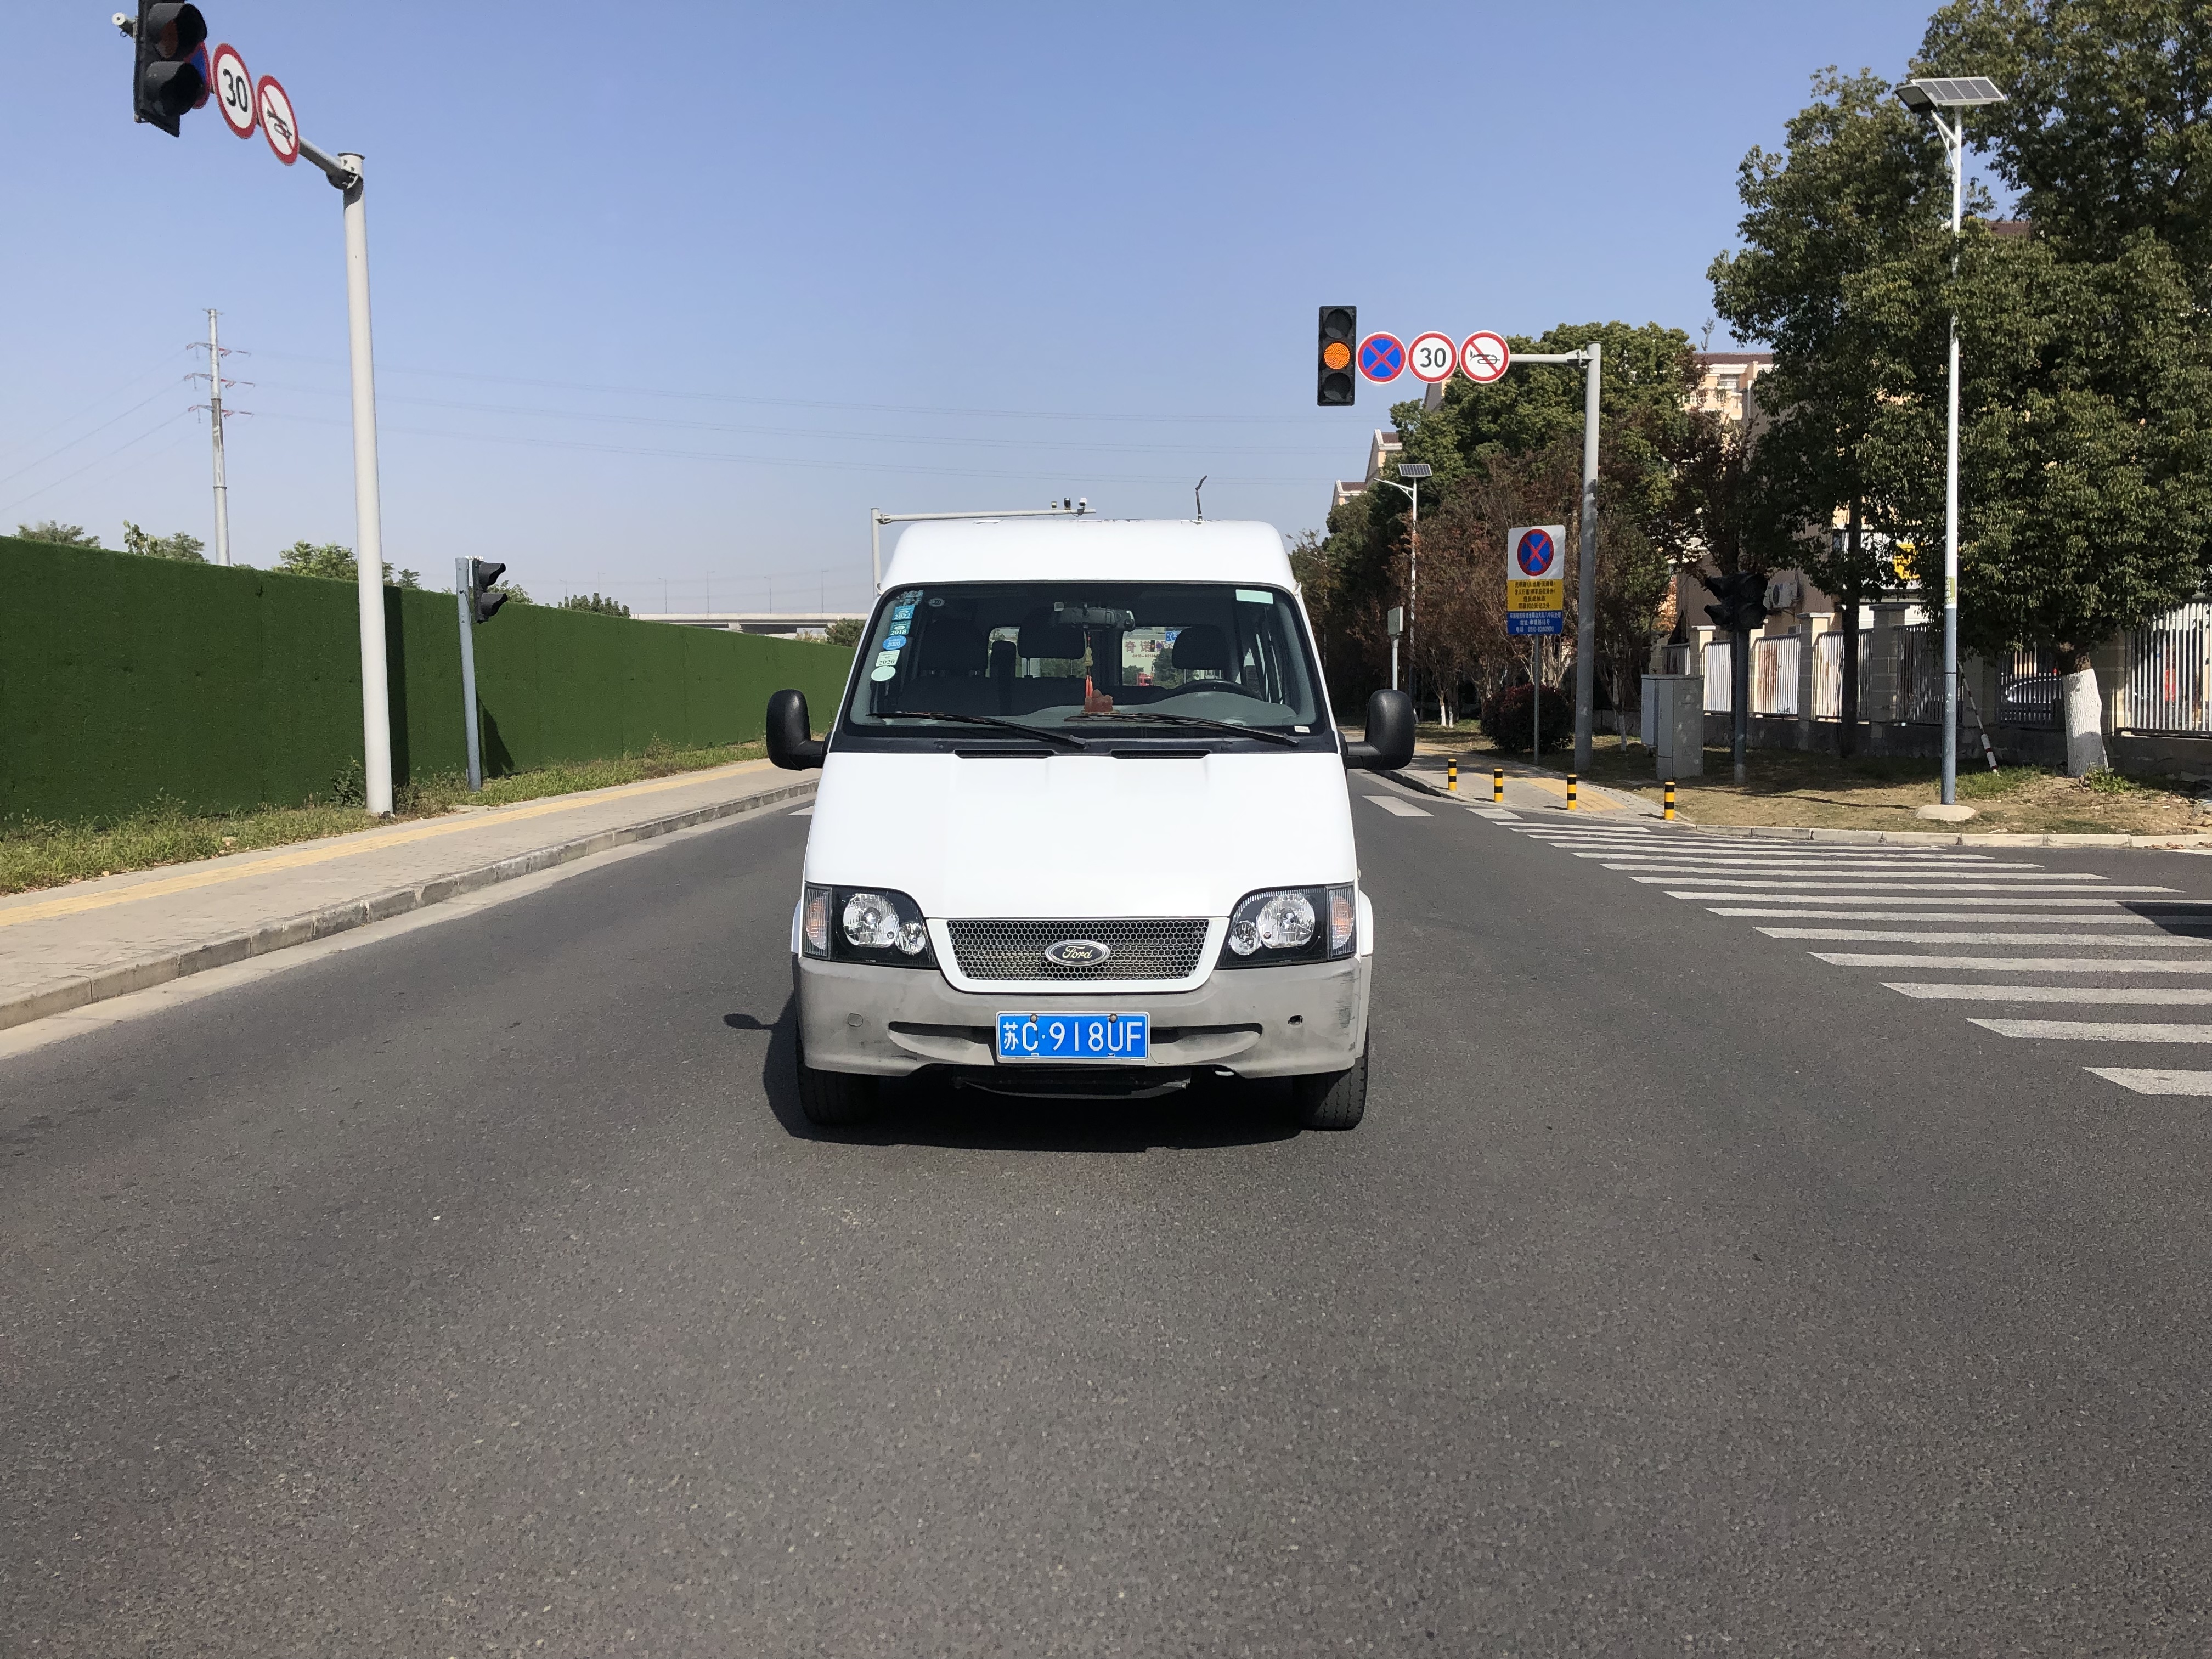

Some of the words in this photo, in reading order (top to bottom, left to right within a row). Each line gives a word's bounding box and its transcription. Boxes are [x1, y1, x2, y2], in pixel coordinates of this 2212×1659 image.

[223, 68, 248, 112] 30
[1419, 347, 1447, 368] 30
[1062, 945, 1093, 960] Ford
